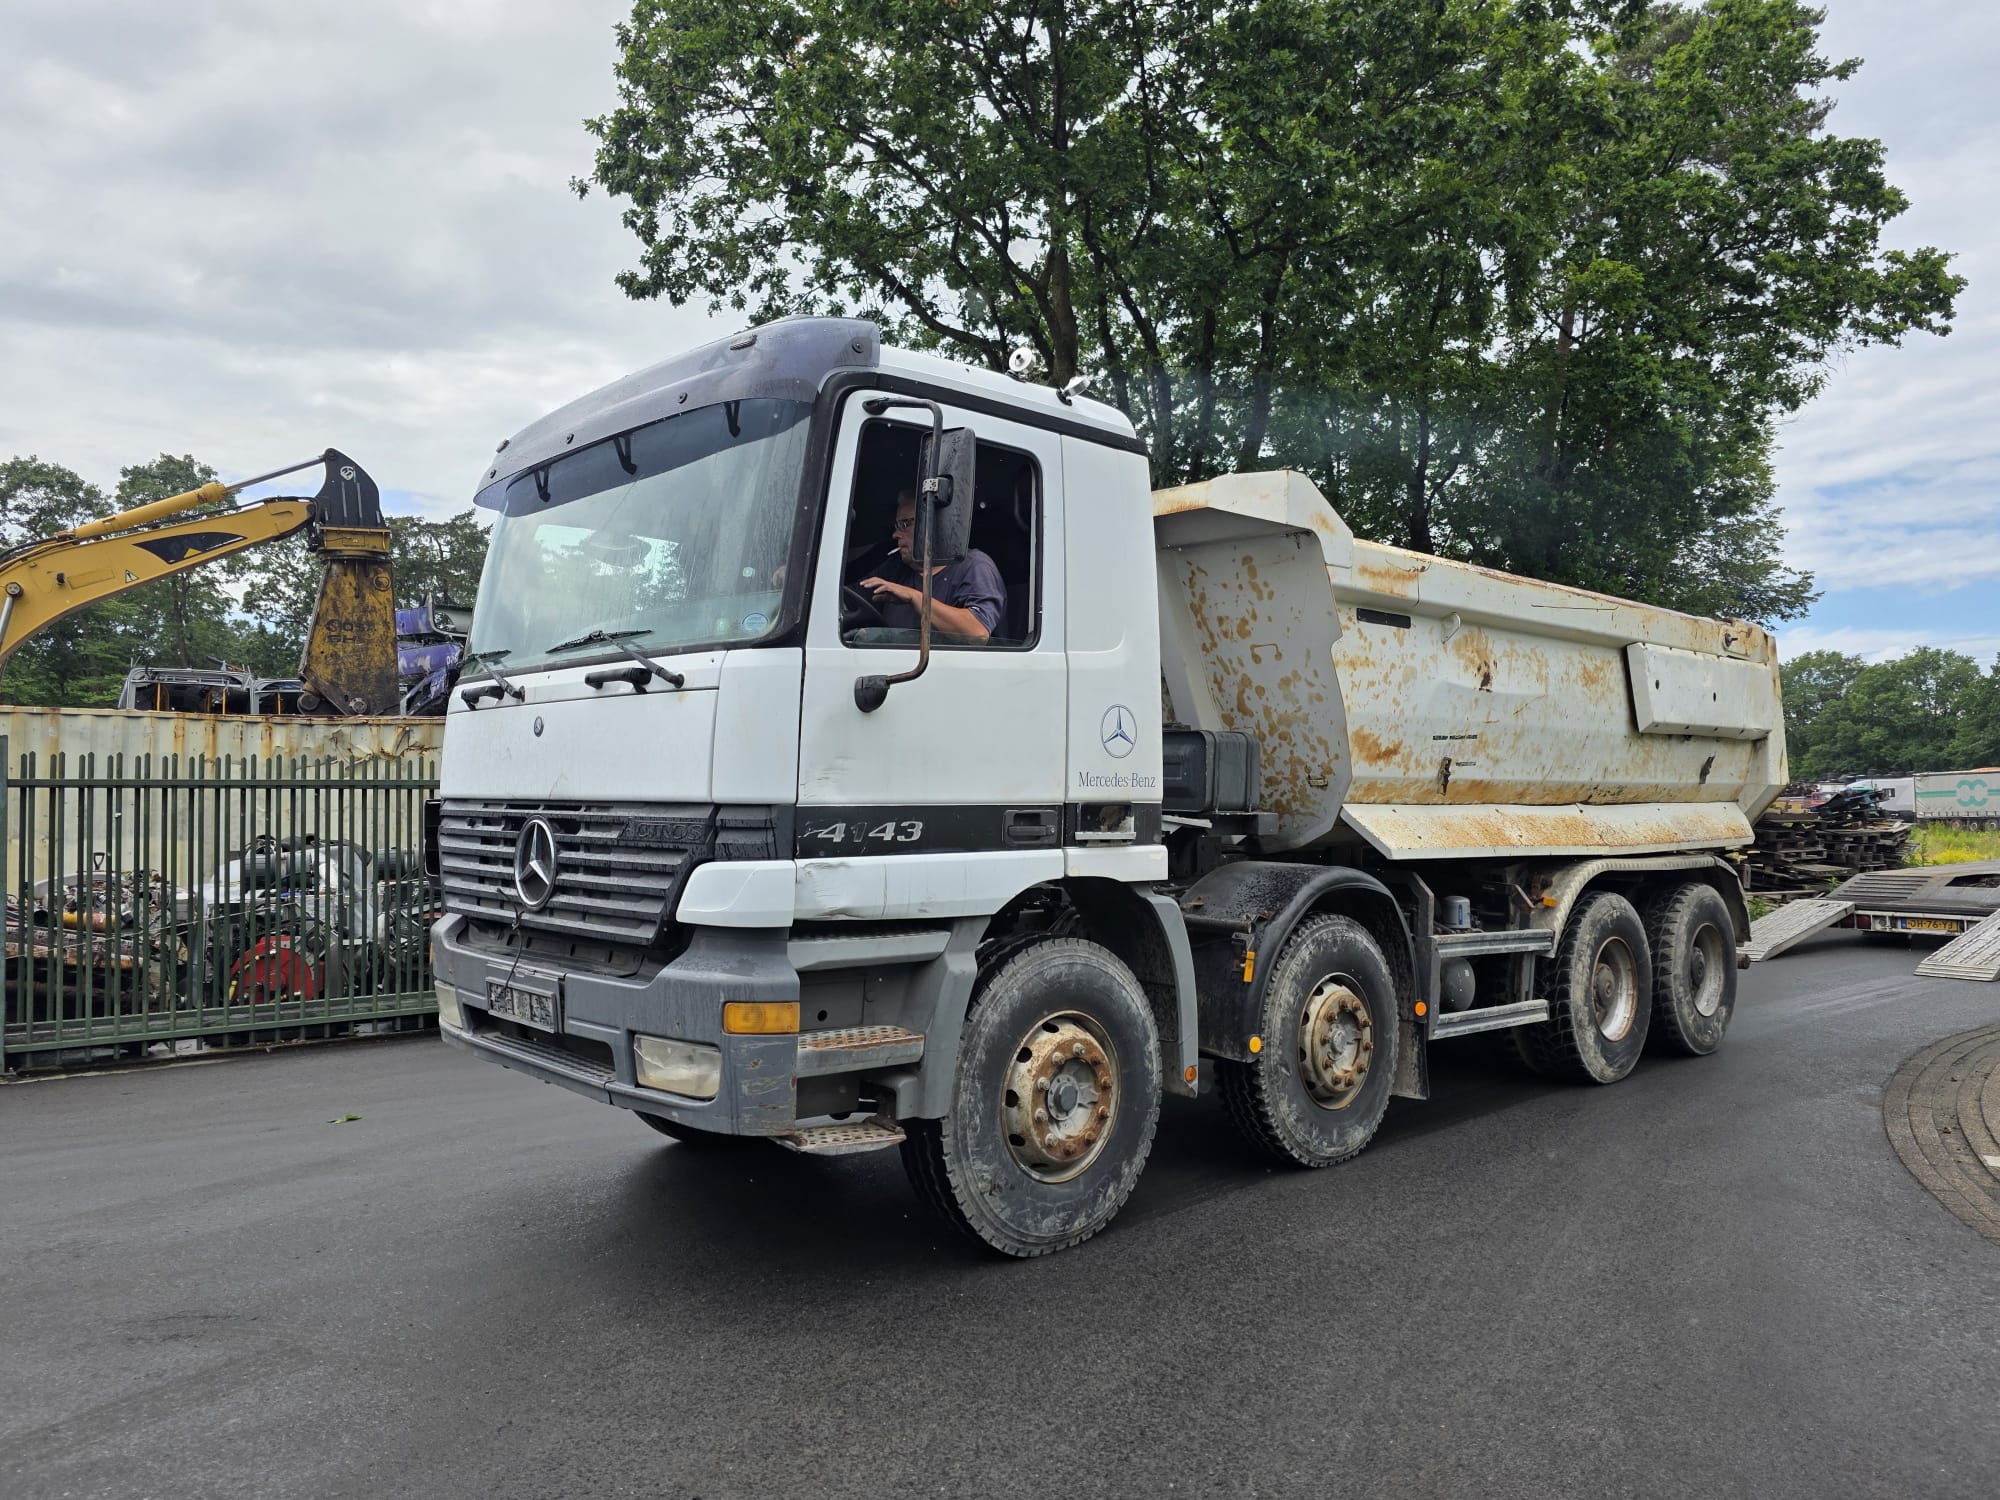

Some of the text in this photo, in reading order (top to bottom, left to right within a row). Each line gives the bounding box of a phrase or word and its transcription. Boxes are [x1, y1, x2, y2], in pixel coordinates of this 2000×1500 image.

[1078, 771, 1157, 788] Mercedes-Benz
[622, 821, 703, 840] ACTROS
[817, 821, 923, 842] 4143
